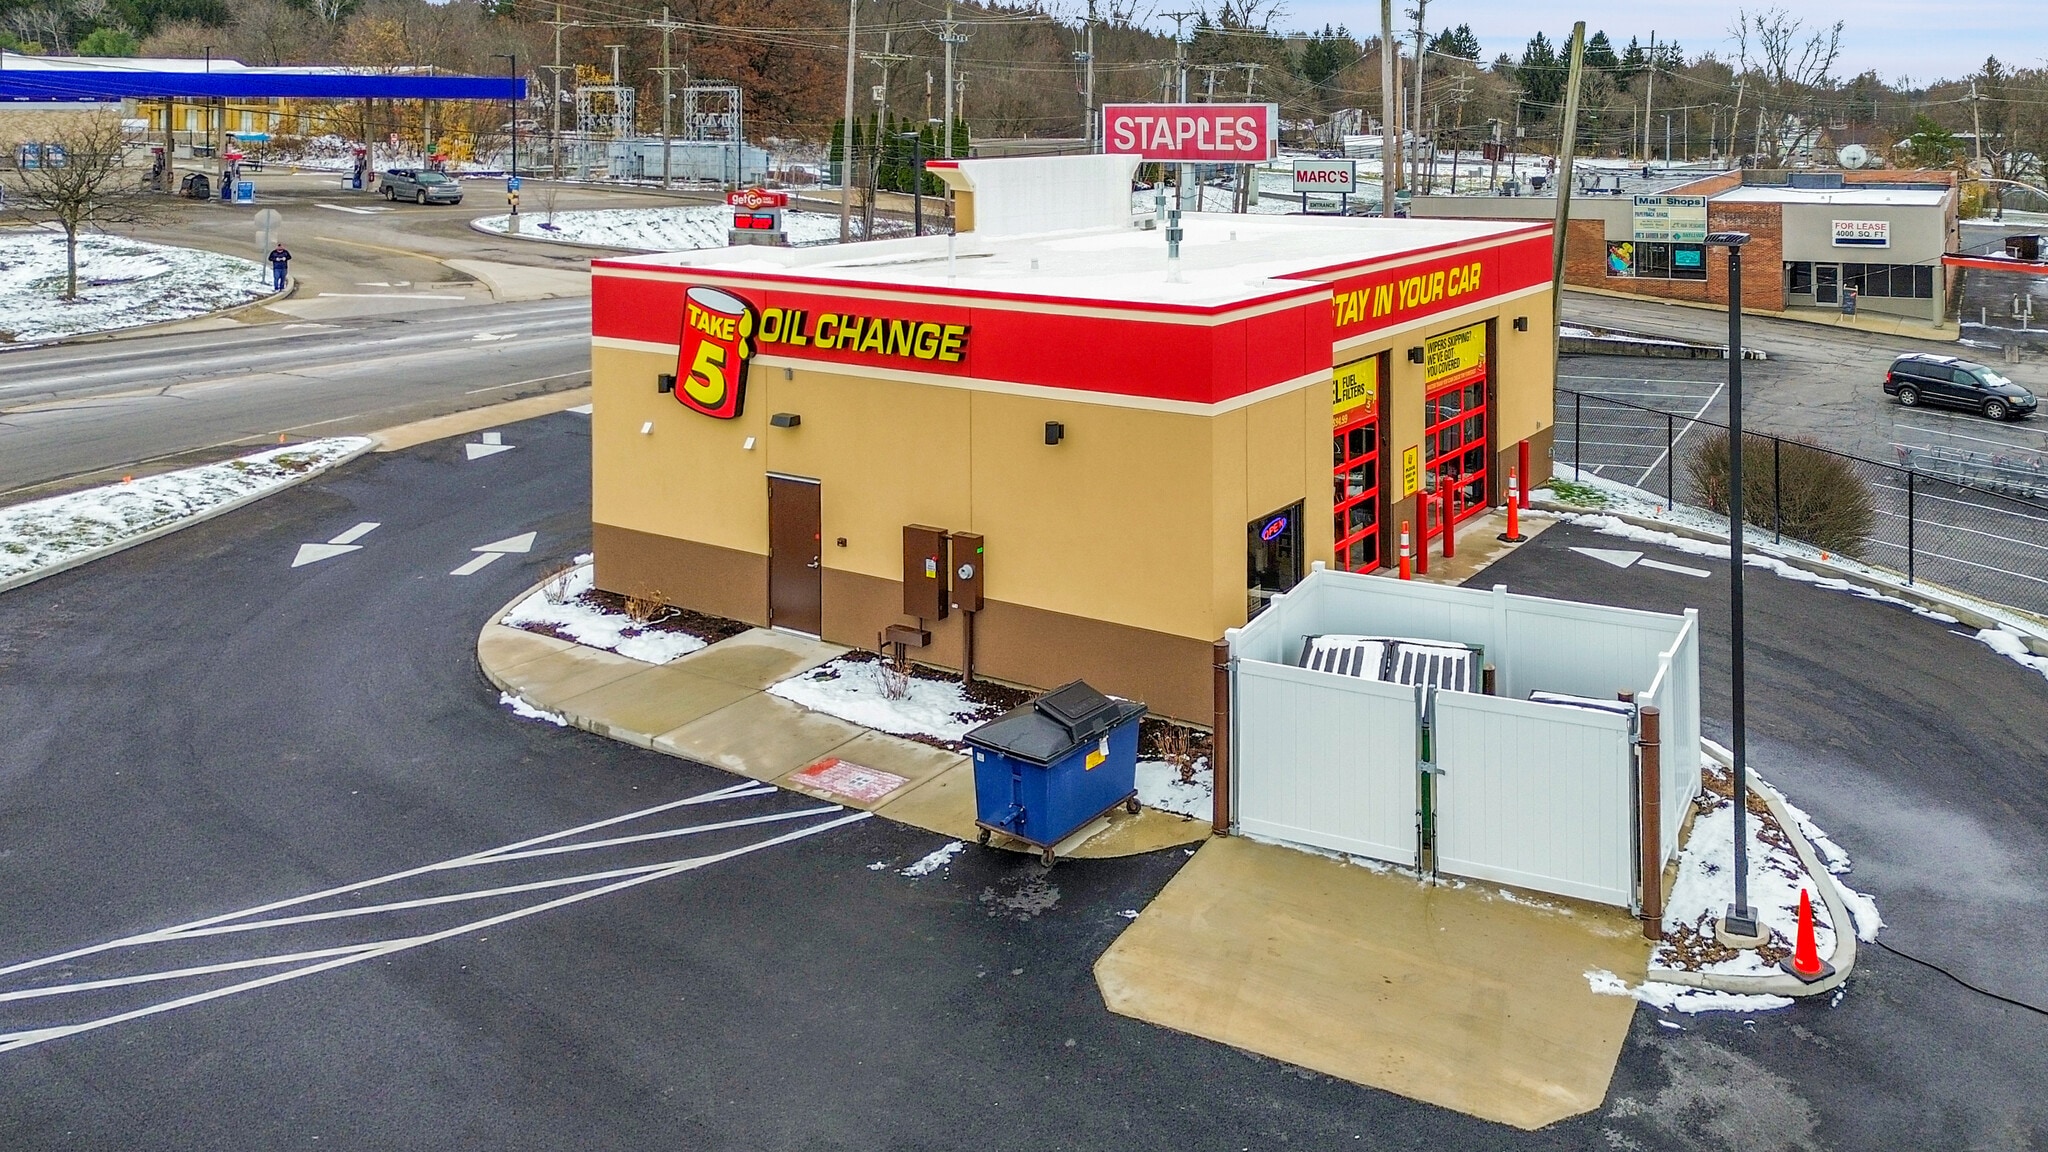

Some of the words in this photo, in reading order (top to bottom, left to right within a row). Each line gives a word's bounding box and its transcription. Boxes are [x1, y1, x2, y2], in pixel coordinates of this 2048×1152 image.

[1114, 116, 1258, 151] STAPLES
[1296, 170, 1348, 183] MARC'S
[732, 193, 762, 206] getGo
[1639, 197, 1662, 205] Mall
[1666, 197, 1701, 207] Shops
[1835, 222, 1854, 230] FOR
[1856, 223, 1887, 231] LEASE
[1858, 230, 1873, 238] SQ.
[1332, 288, 1371, 327] TAY
[1372, 283, 1394, 318] IN
[1399, 271, 1445, 311] YOUR
[1447, 262, 1482, 297] CAR
[687, 303, 736, 341] TAKE
[759, 308, 808, 347] OIL
[814, 313, 967, 362] CHANGE
[1427, 338, 1447, 354] WIPERS
[1447, 330, 1472, 347] SKIPPING?
[1427, 350, 1444, 366] WE'VE
[1444, 347, 1454, 361] GOT
[684, 339, 725, 405] 5
[1427, 365, 1437, 378] YOU
[1438, 357, 1460, 374] COVERED
[1342, 373, 1357, 389] FUEL
[1342, 383, 1365, 401] FILTERS
[1263, 519, 1284, 541] OPEN
